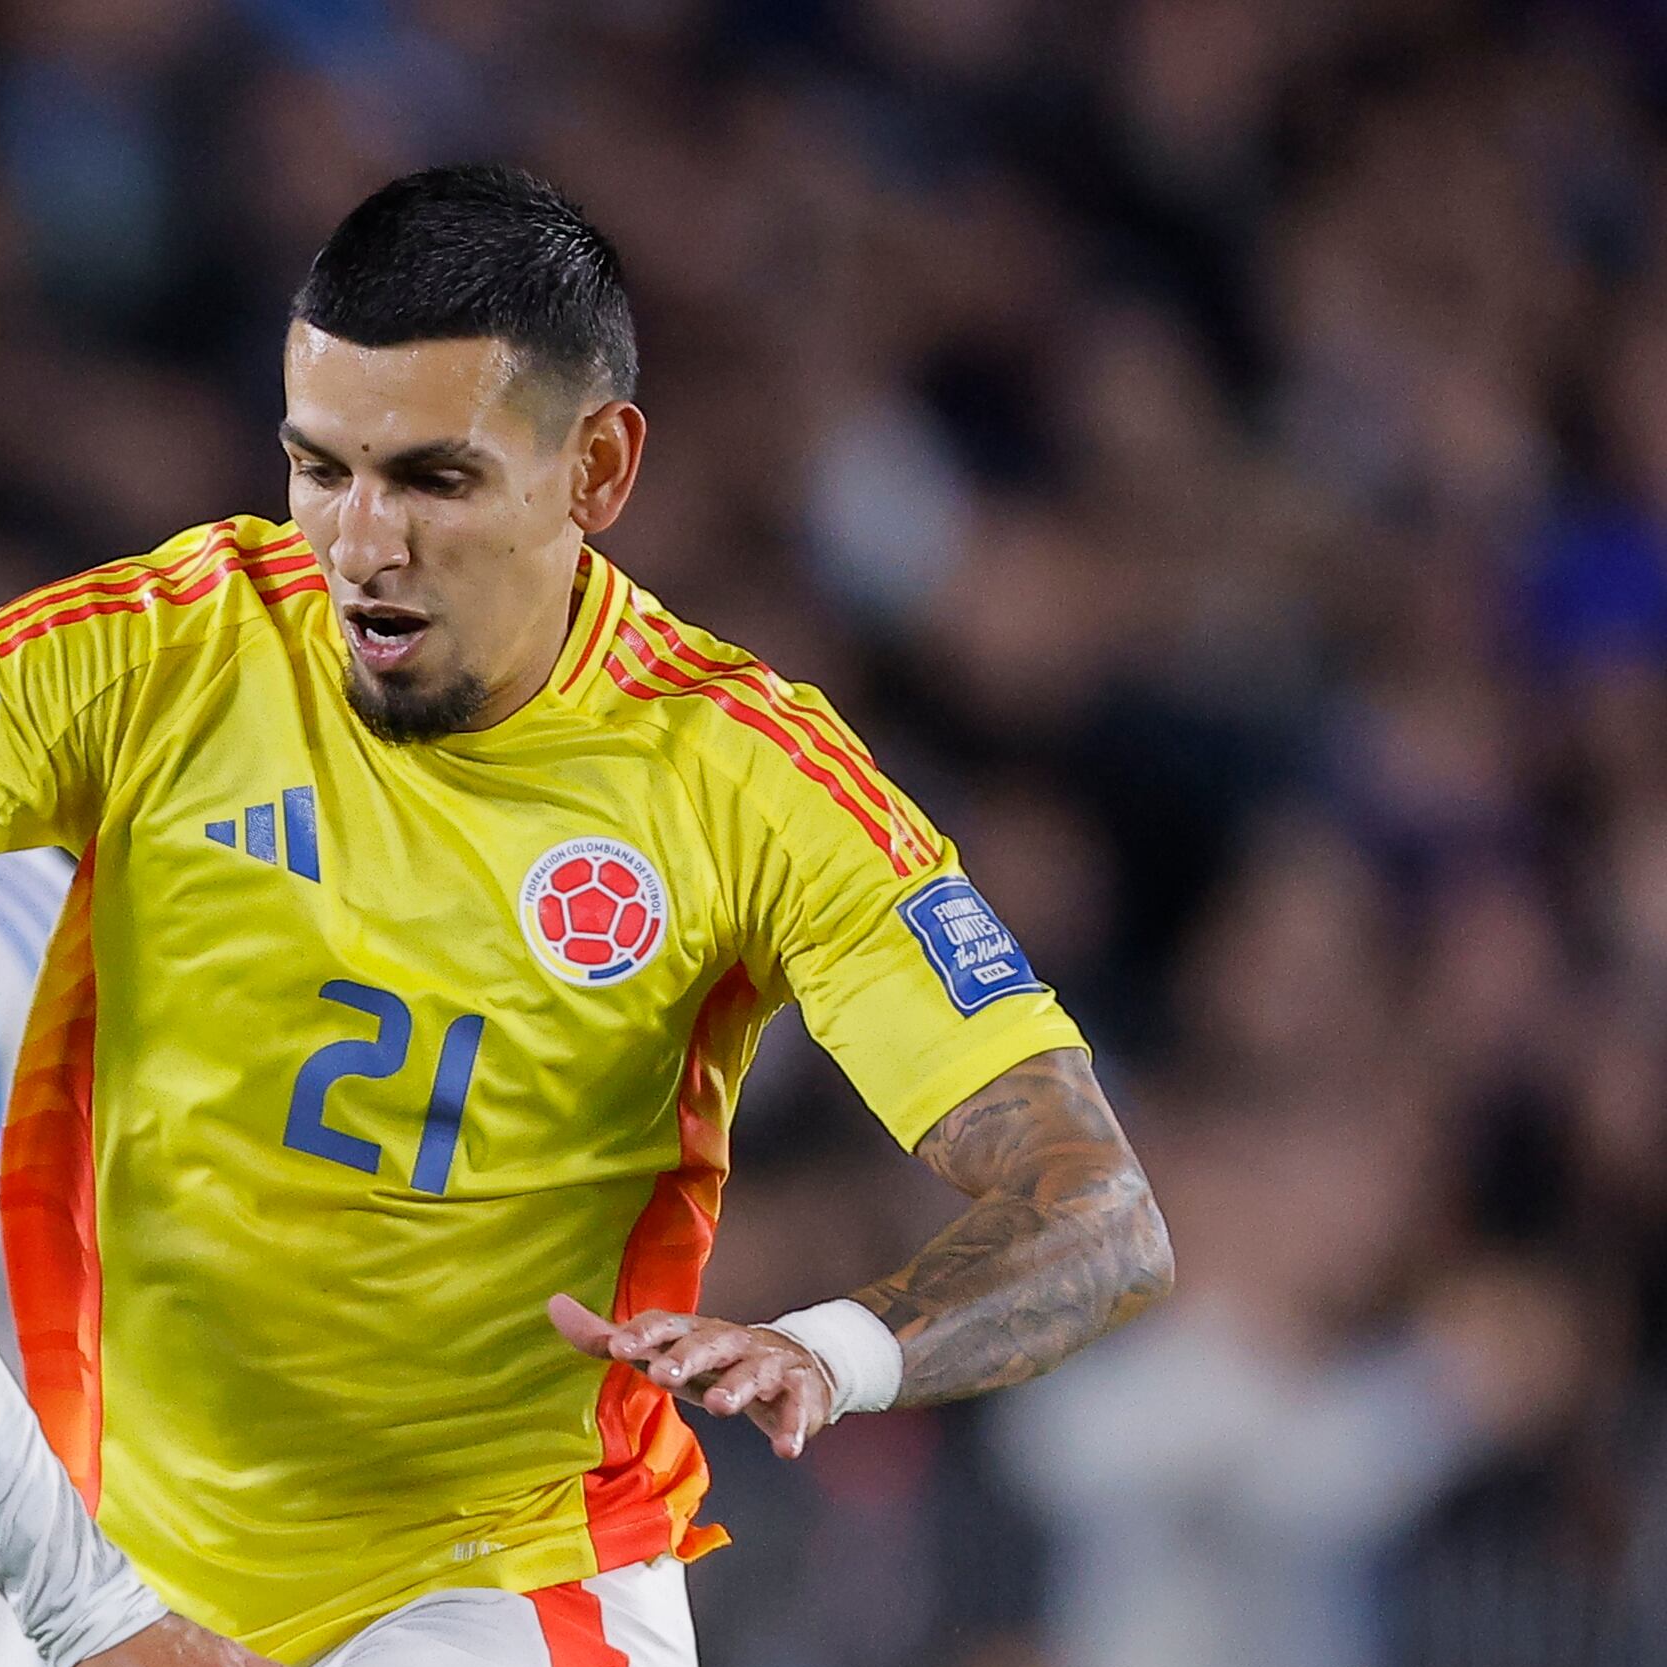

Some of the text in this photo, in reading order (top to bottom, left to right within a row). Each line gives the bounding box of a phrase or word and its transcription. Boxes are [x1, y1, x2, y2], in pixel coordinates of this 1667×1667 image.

[567, 842, 634, 866] COLOMBIANA
[633, 861, 647, 876] DE
[942, 913, 1000, 946] UNITES
[953, 933, 1015, 970] the World
[980, 966, 1009, 980] FIFA
[282, 978, 486, 1197] 21
